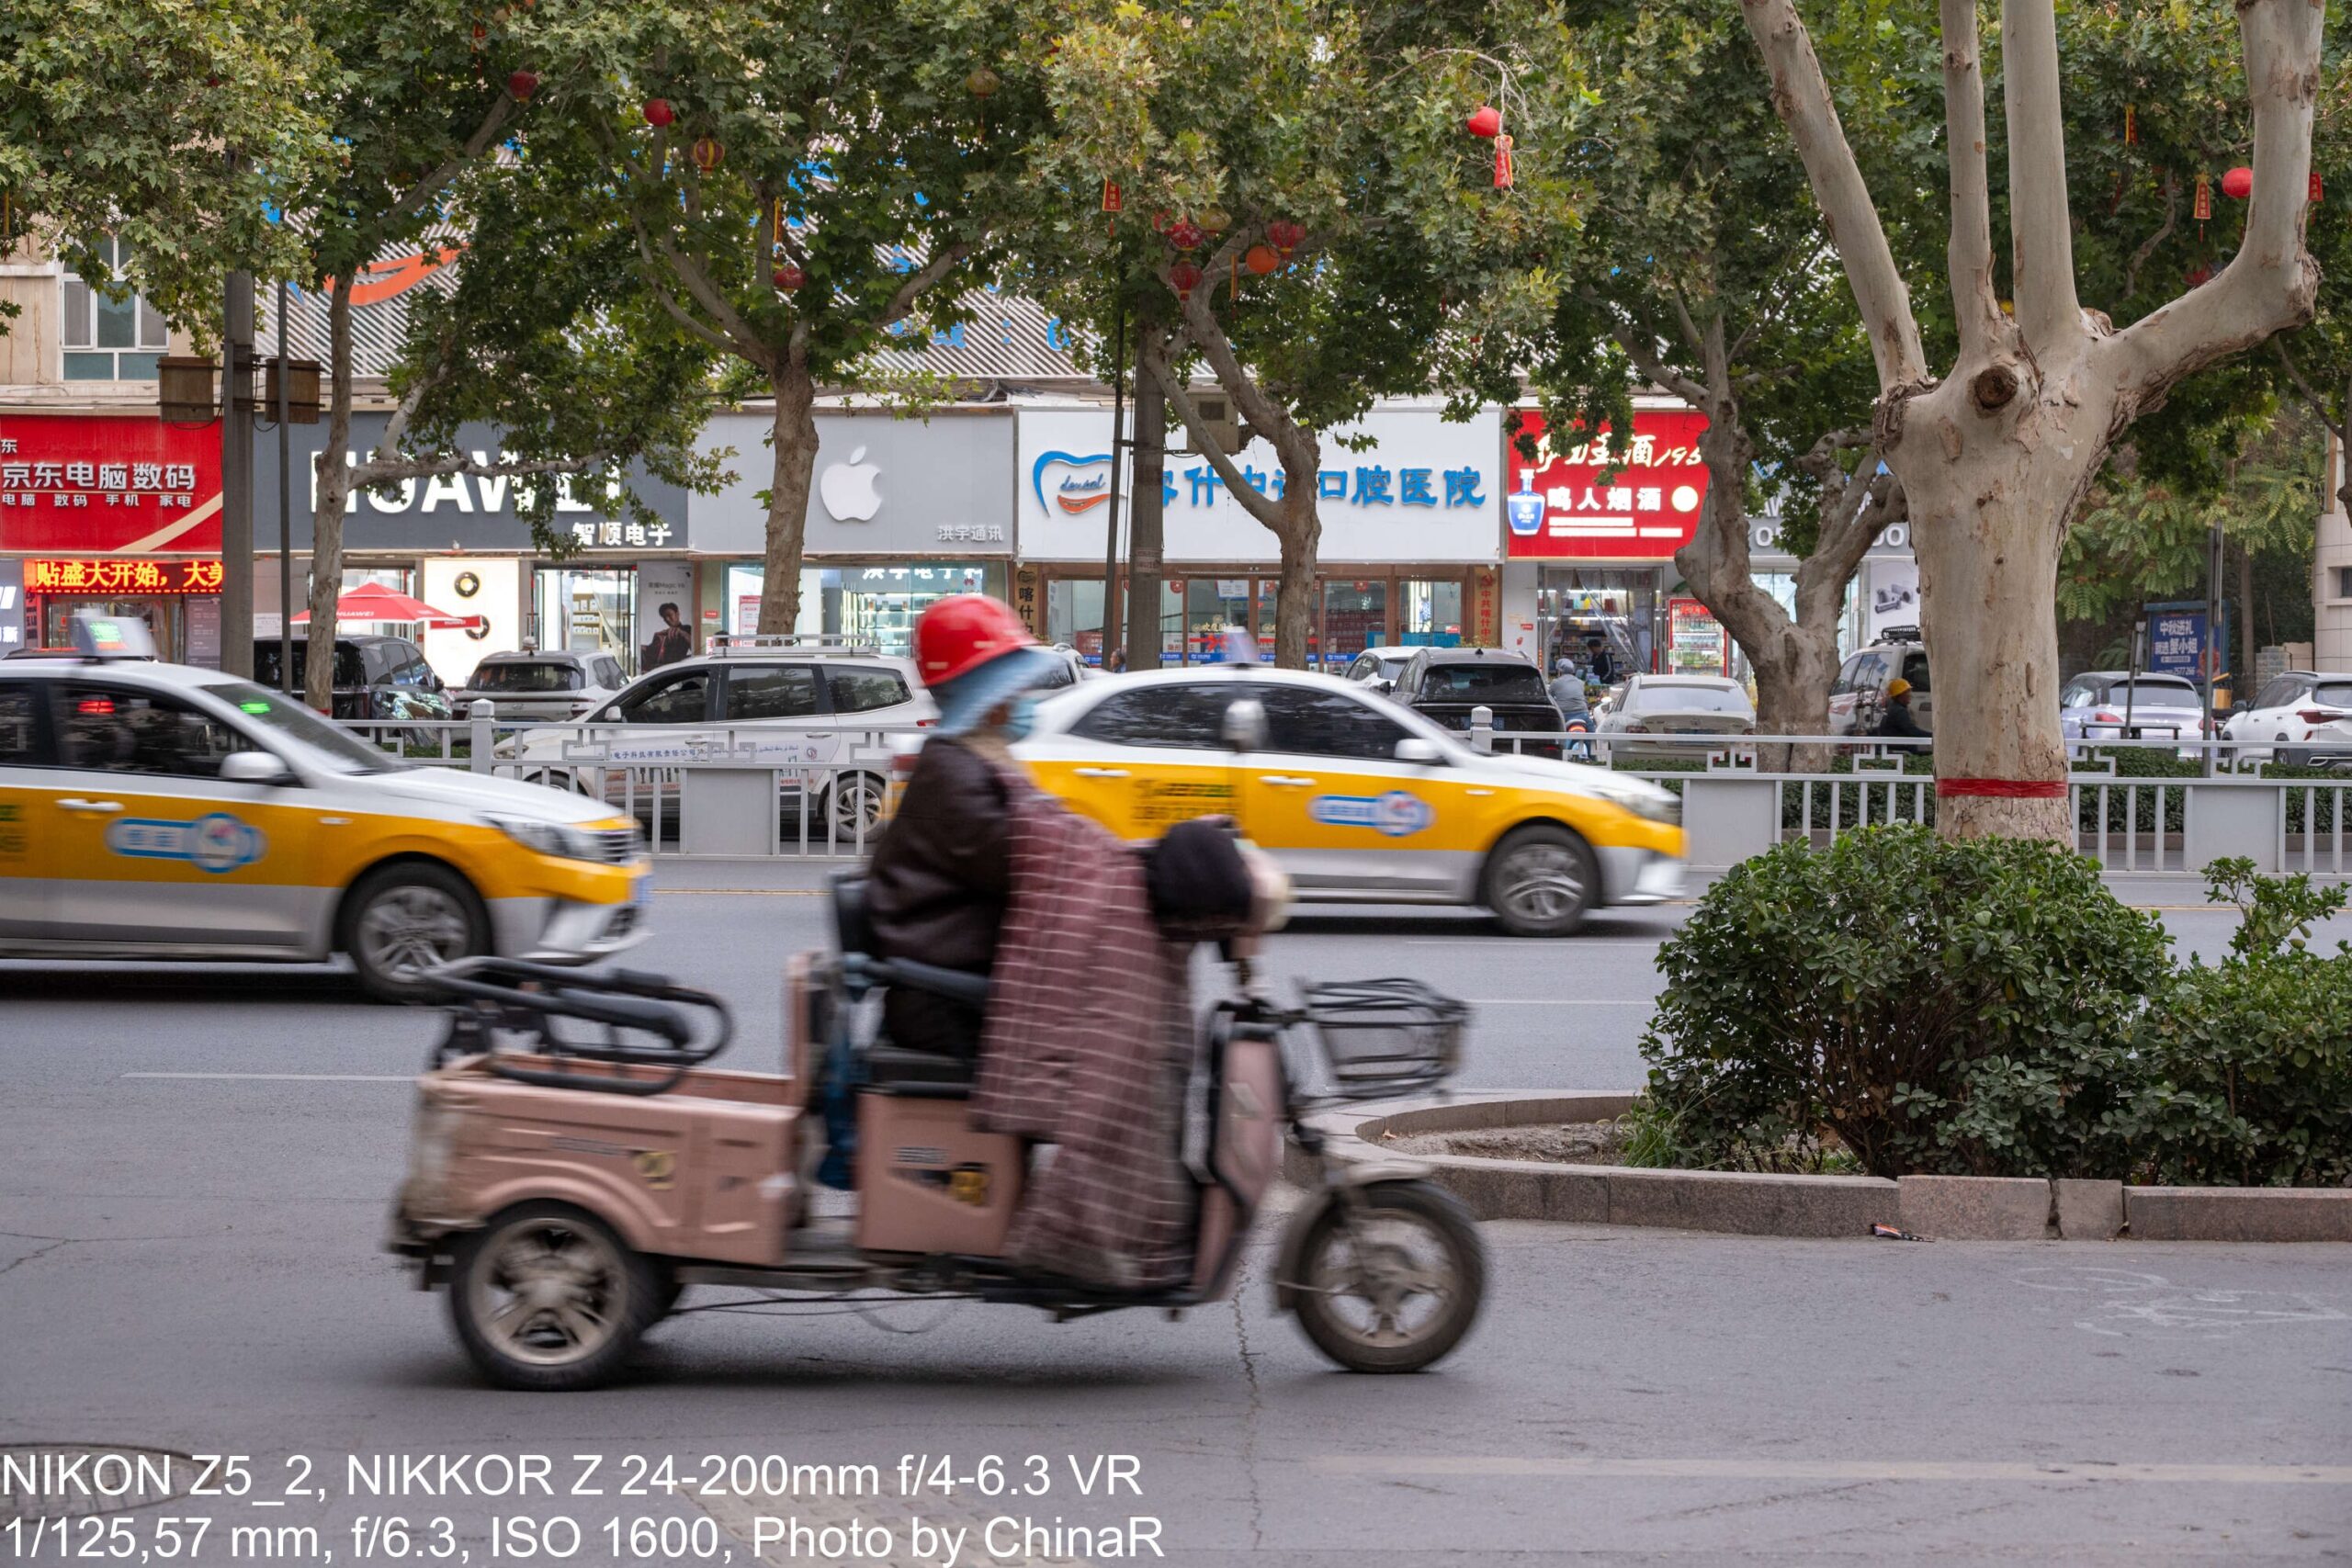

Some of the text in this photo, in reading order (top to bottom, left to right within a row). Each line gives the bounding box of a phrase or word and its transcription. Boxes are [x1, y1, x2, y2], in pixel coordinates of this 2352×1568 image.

[2, 462, 196, 491] 京东电脑数码
[1163, 464, 1487, 508] 什中口腔医院
[3, 494, 192, 508] 电脑 数码 手机 家电
[572, 521, 673, 547] 智顺电子
[938, 525, 1004, 542] 洪宇通讯
[610, 749, 695, 759] 电子科技有限责任公司
